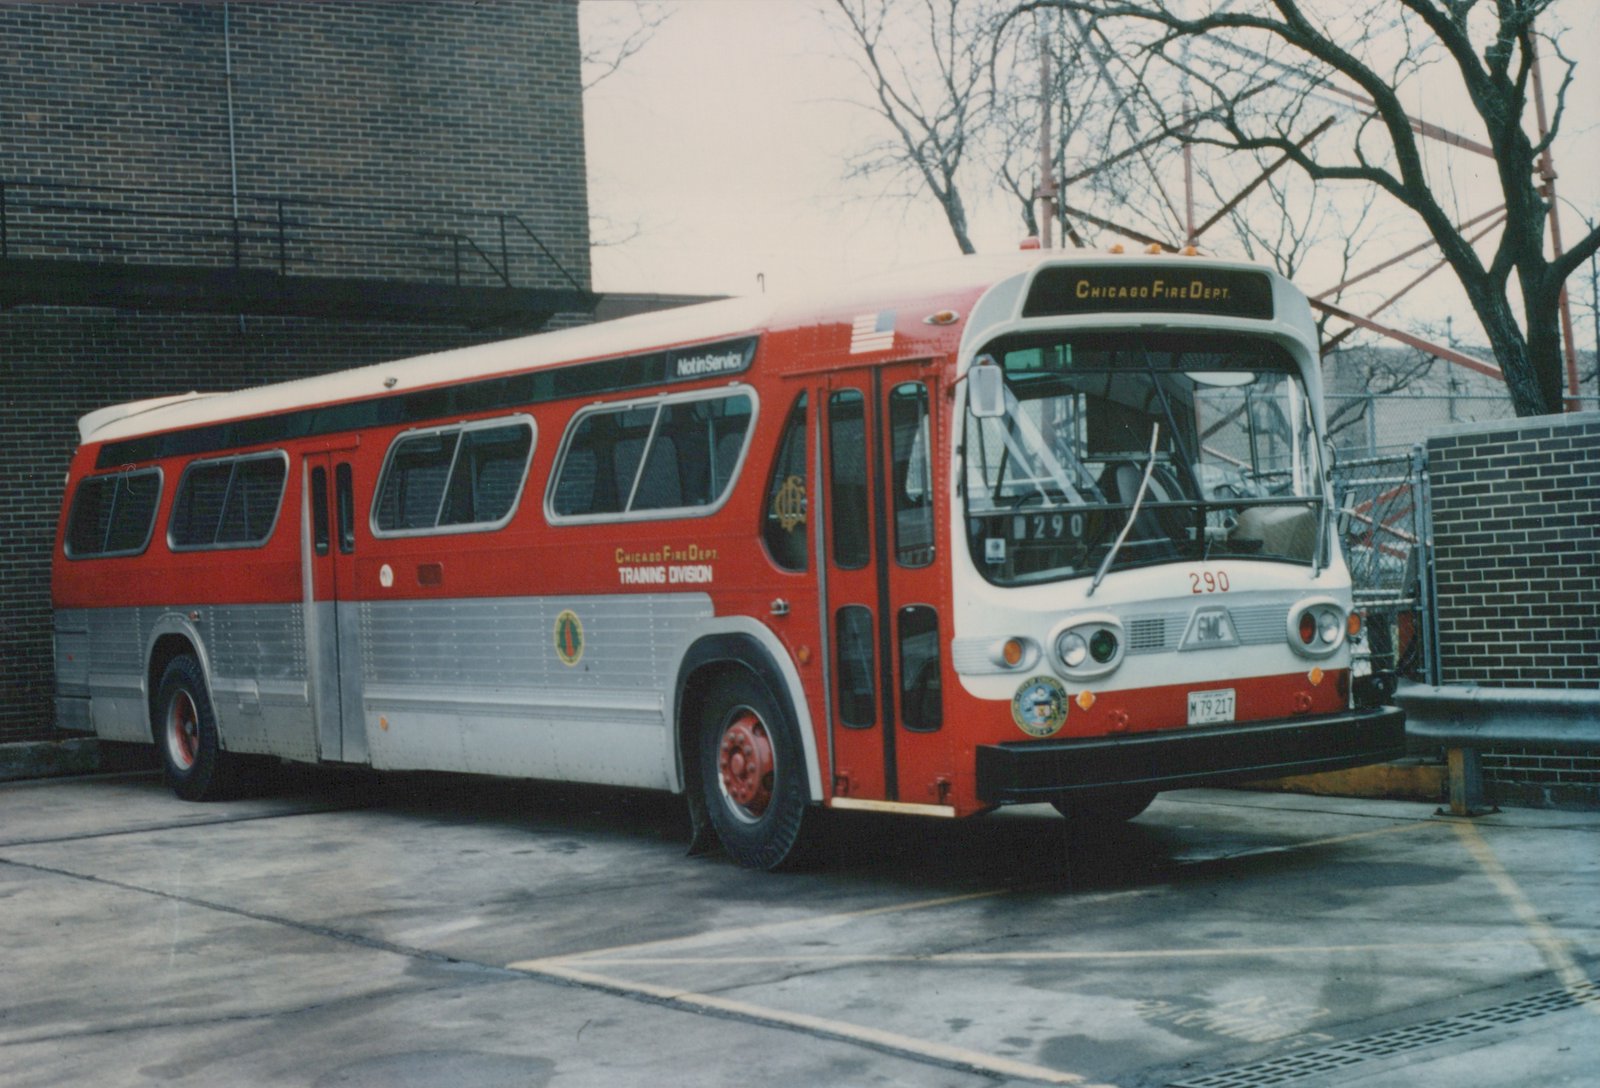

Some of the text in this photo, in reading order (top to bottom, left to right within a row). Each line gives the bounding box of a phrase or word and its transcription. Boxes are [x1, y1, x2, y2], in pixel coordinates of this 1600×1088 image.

[1076, 280, 1148, 298] CHICAGO
[1152, 280, 1187, 298] FIRE
[677, 356, 696, 376] Not
[696, 356, 706, 373] in
[1033, 514, 1082, 539] 290
[615, 548, 660, 564] CHICAGO
[663, 545, 687, 561] FIRE
[618, 565, 712, 584] TRAINING DIVISION
[1189, 571, 1230, 594] 290
[1198, 615, 1225, 641] GMC
